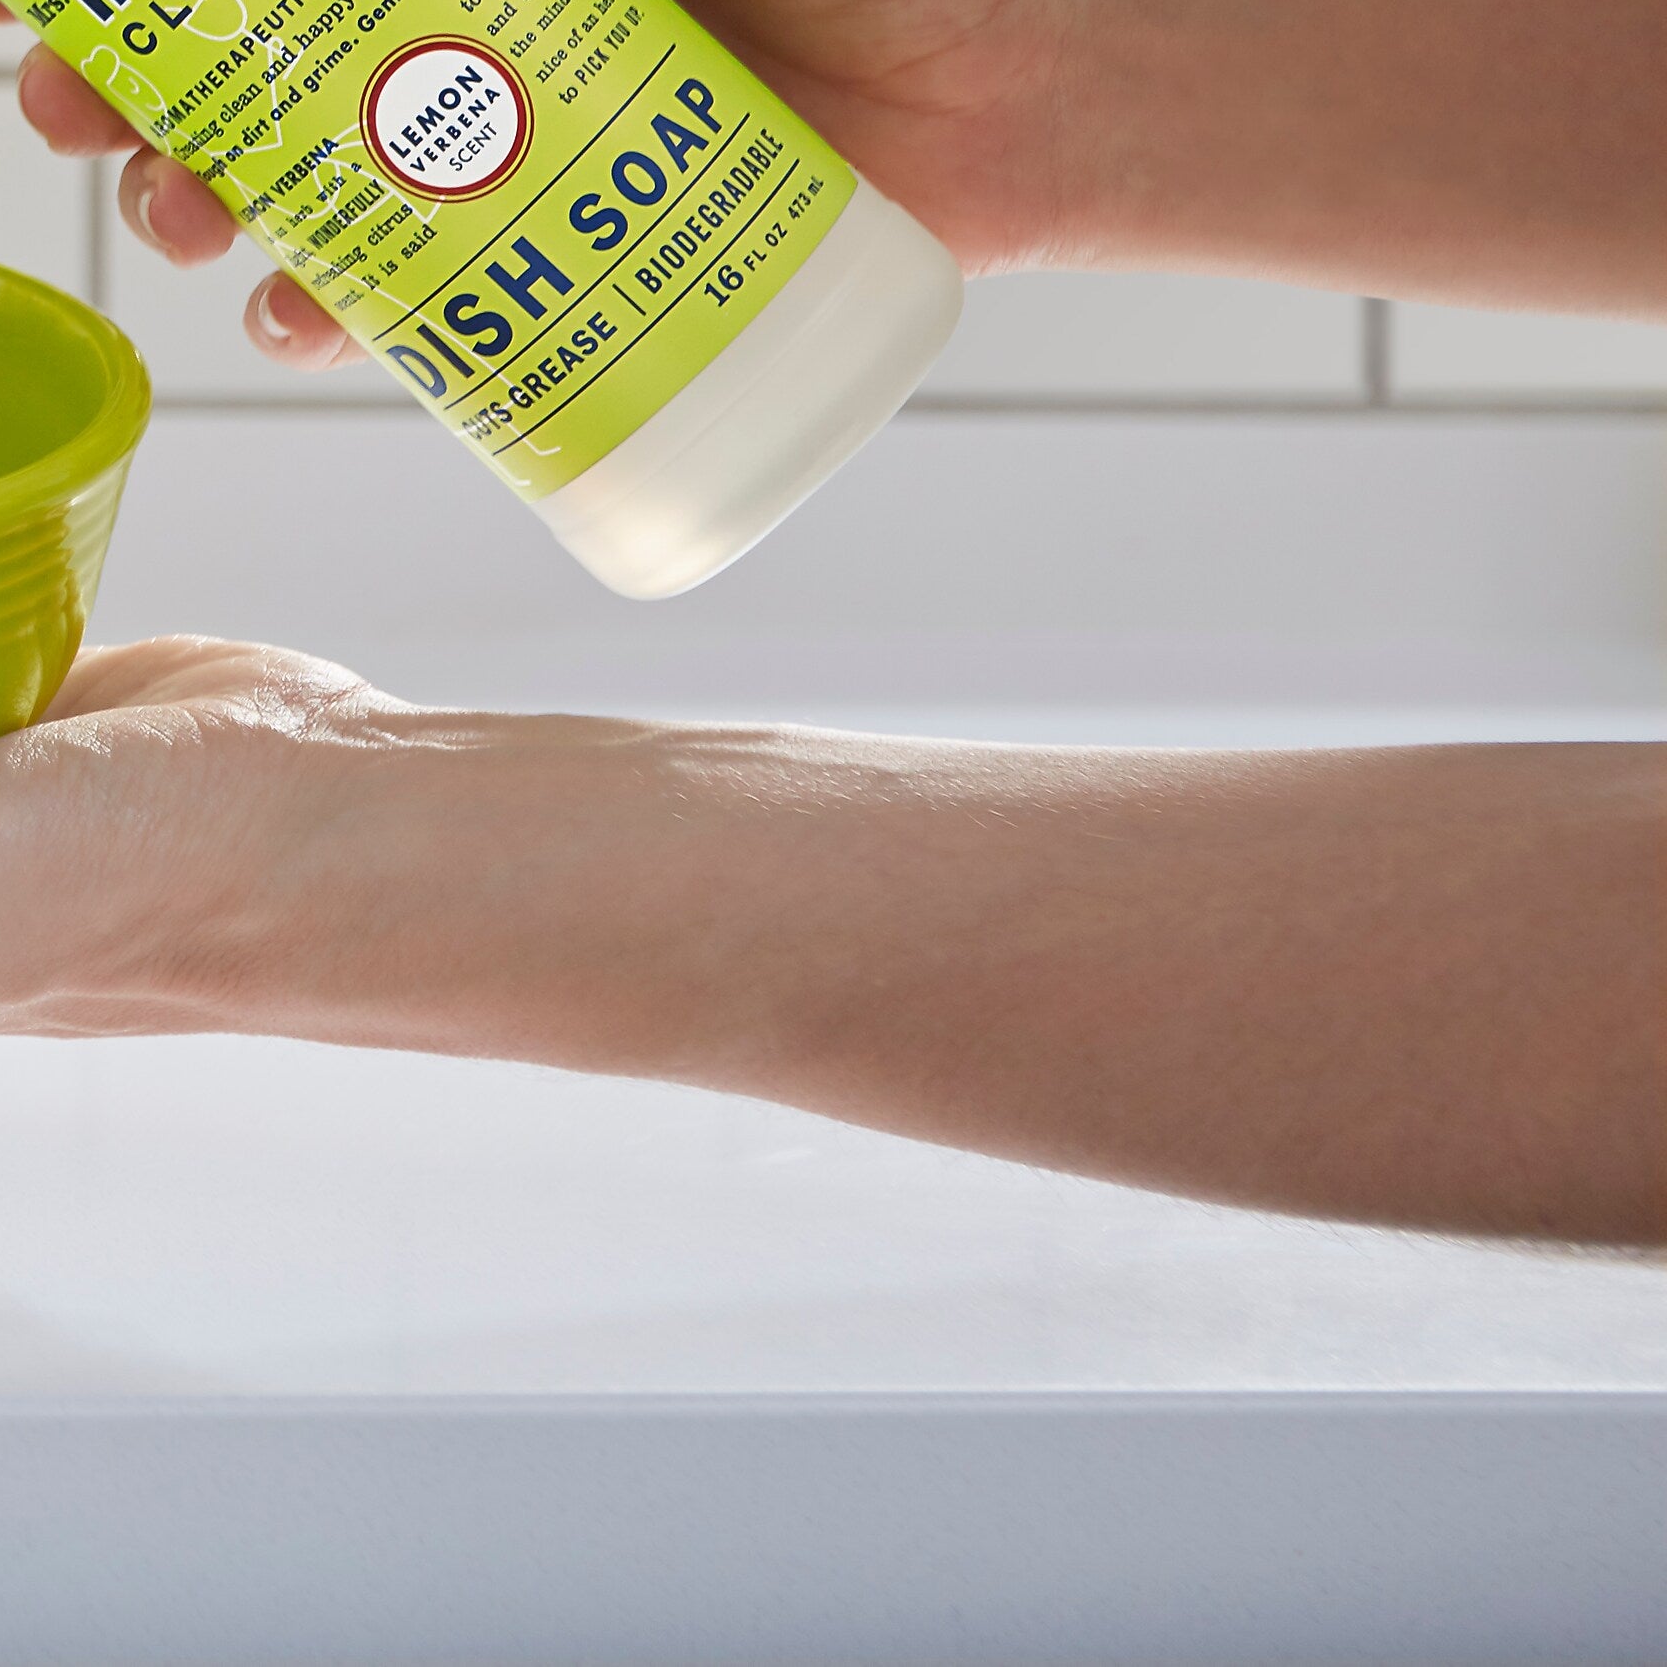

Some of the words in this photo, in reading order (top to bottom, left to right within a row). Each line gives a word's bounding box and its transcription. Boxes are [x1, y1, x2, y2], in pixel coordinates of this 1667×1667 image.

[486, 0, 519, 37] and
[508, 31, 537, 59] the
[535, 48, 569, 85] nice
[566, 26, 584, 50] of
[581, 12, 600, 34] an
[219, 82, 264, 124] clean
[260, 43, 299, 86] and
[557, 85, 579, 105] to
[573, 46, 611, 86] PICK
[603, 21, 631, 51] YOU
[225, 144, 245, 163] on
[241, 117, 271, 148] dirt
[269, 84, 304, 122] and
[302, 37, 360, 94] grime.
[388, 64, 484, 160] LEMON
[409, 87, 501, 173] VERBENA
[269, 136, 341, 198] VERBENA
[315, 175, 348, 203] with
[350, 161, 363, 174] a
[448, 120, 498, 172] SCENT
[306, 178, 386, 251] WONDERFULLY
[367, 203, 414, 247] citrus
[385, 234, 576, 400] DISH
[568, 77, 723, 252] SOAP
[703, 263, 745, 308] 16
[742, 248, 768, 273] FL
[764, 220, 789, 248] OZ
[787, 191, 812, 220] 473
[360, 273, 381, 292] It
[377, 259, 399, 278] is
[400, 223, 439, 261] said
[507, 310, 619, 410] GREASE
[634, 126, 784, 295] BIODEGRADABLE
